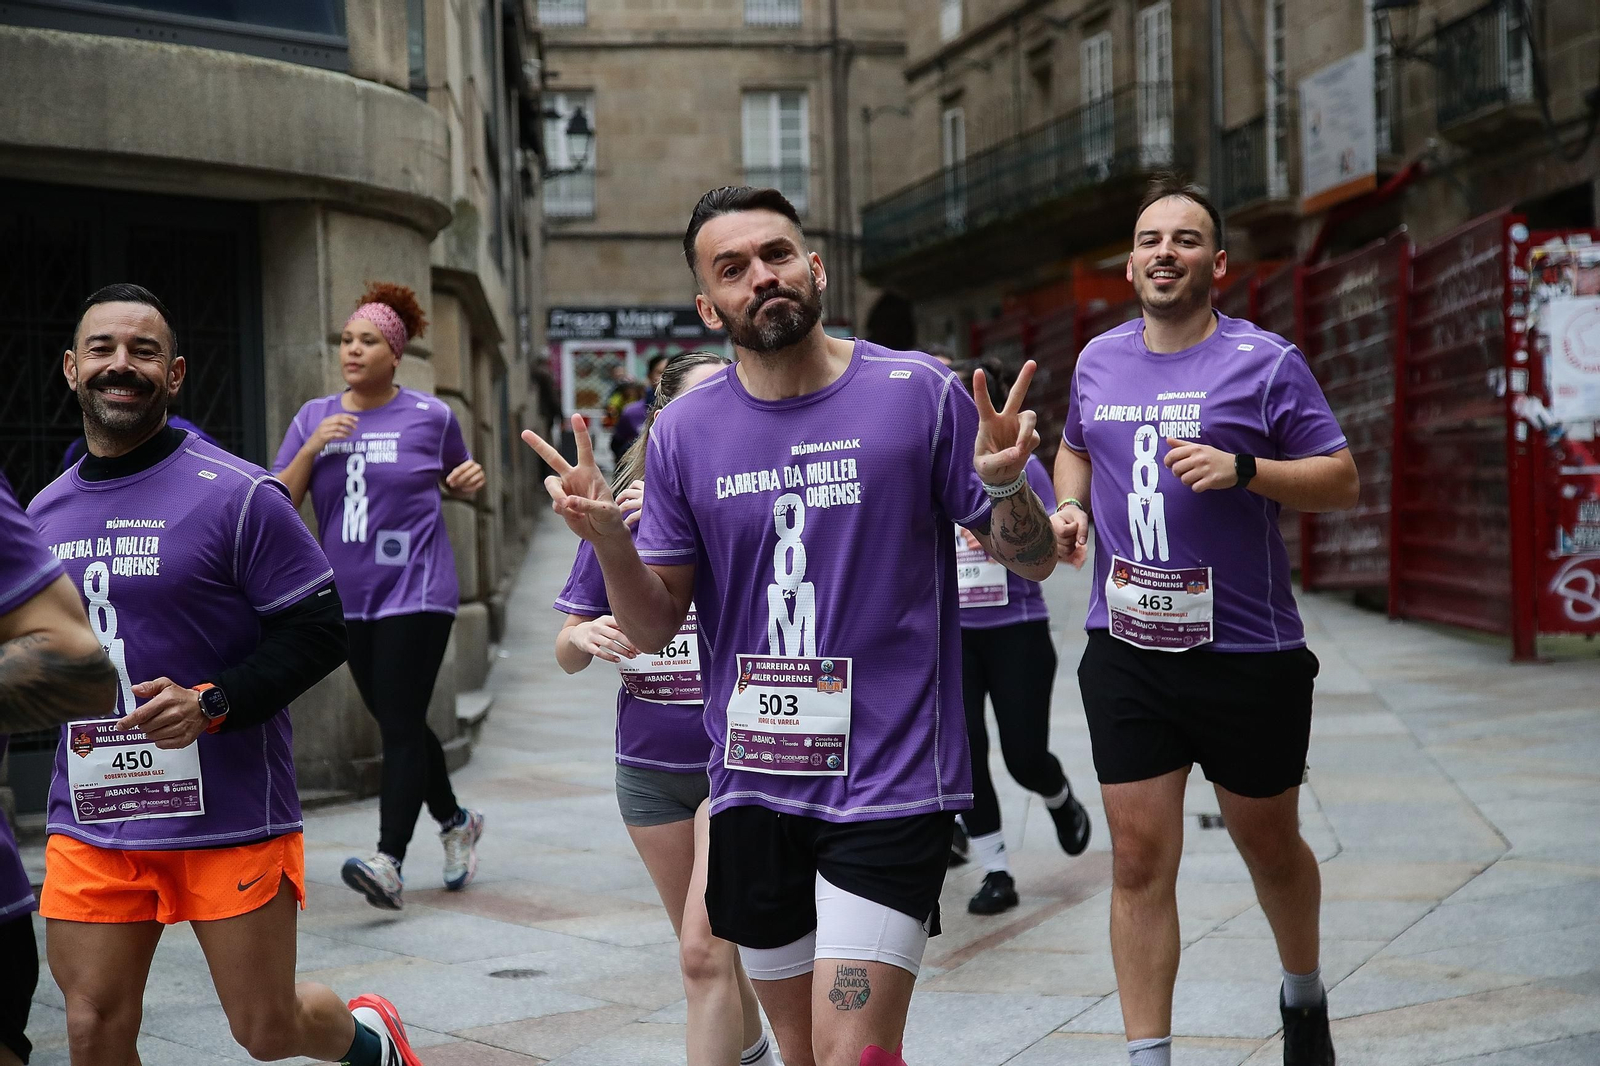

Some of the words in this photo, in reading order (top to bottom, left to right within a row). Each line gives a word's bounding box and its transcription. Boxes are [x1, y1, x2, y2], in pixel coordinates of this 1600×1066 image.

[1156, 391, 1207, 400] RUNMANIAK
[1094, 404, 1142, 422] CARREIRA
[1145, 405, 1159, 421] DA
[1161, 404, 1201, 421] MULLER
[1159, 421, 1201, 438] OURENSE
[355, 440, 366, 453] DA
[791, 439, 861, 455] RUNMANIAK
[716, 468, 781, 499] CARREIRA
[783, 464, 804, 488] DA
[806, 458, 857, 485] MULLER
[341, 453, 369, 543] 8M
[806, 482, 861, 509] OURENSE
[1127, 424, 1169, 563] 8M
[106, 518, 166, 529] RUNMANIAK
[48, 538, 93, 560] ARREIRA
[96, 537, 112, 557] DA
[115, 536, 159, 555] MULLER
[112, 557, 160, 577] OURENSE
[1131, 575, 1152, 586] MULLER
[1140, 570, 1170, 580] CARREIRA
[1138, 594, 1173, 610] 463
[761, 662, 795, 671] CARREIRA
[797, 663, 810, 671] DA
[645, 674, 674, 682] ABANCA
[772, 674, 813, 683] OURENSE
[759, 693, 799, 716] 503
[95, 733, 125, 743] MULLER
[126, 733, 147, 741] OURE
[752, 735, 776, 745] ABANCA
[112, 750, 153, 770] 450
[105, 787, 140, 797] ABANCA
[172, 785, 197, 793] OURENSE
